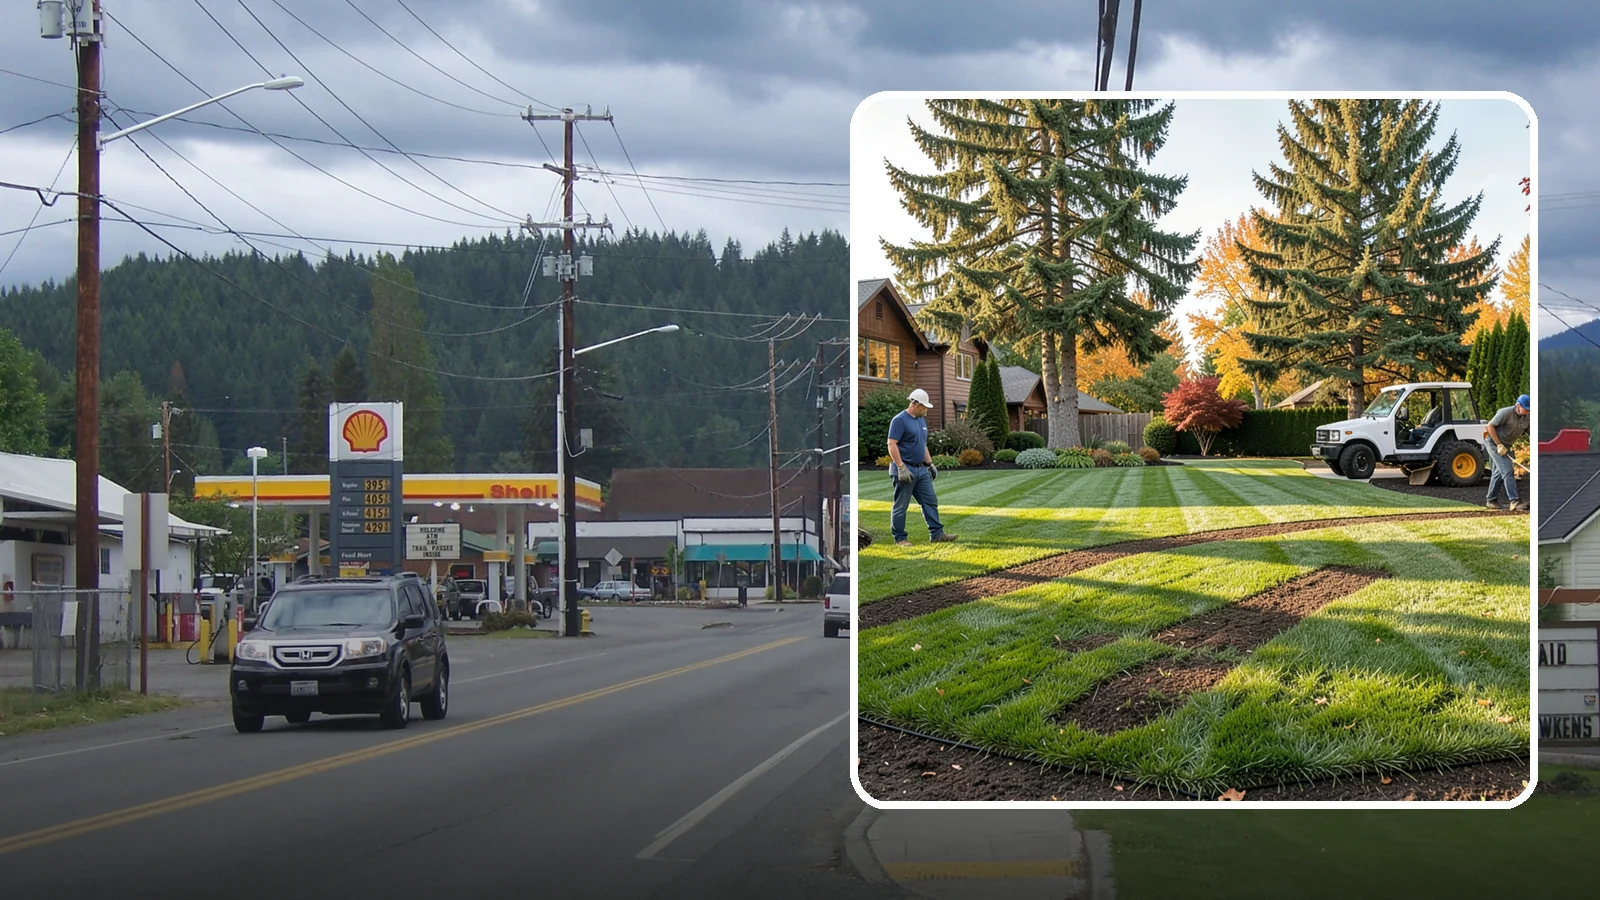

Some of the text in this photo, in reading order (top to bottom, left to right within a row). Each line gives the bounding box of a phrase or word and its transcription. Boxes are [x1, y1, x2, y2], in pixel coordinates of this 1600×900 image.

[366, 480, 383, 490] 395
[490, 484, 547, 498] Shell
[366, 494, 383, 504] 405
[365, 508, 383, 518] 415
[366, 522, 384, 532] 429
